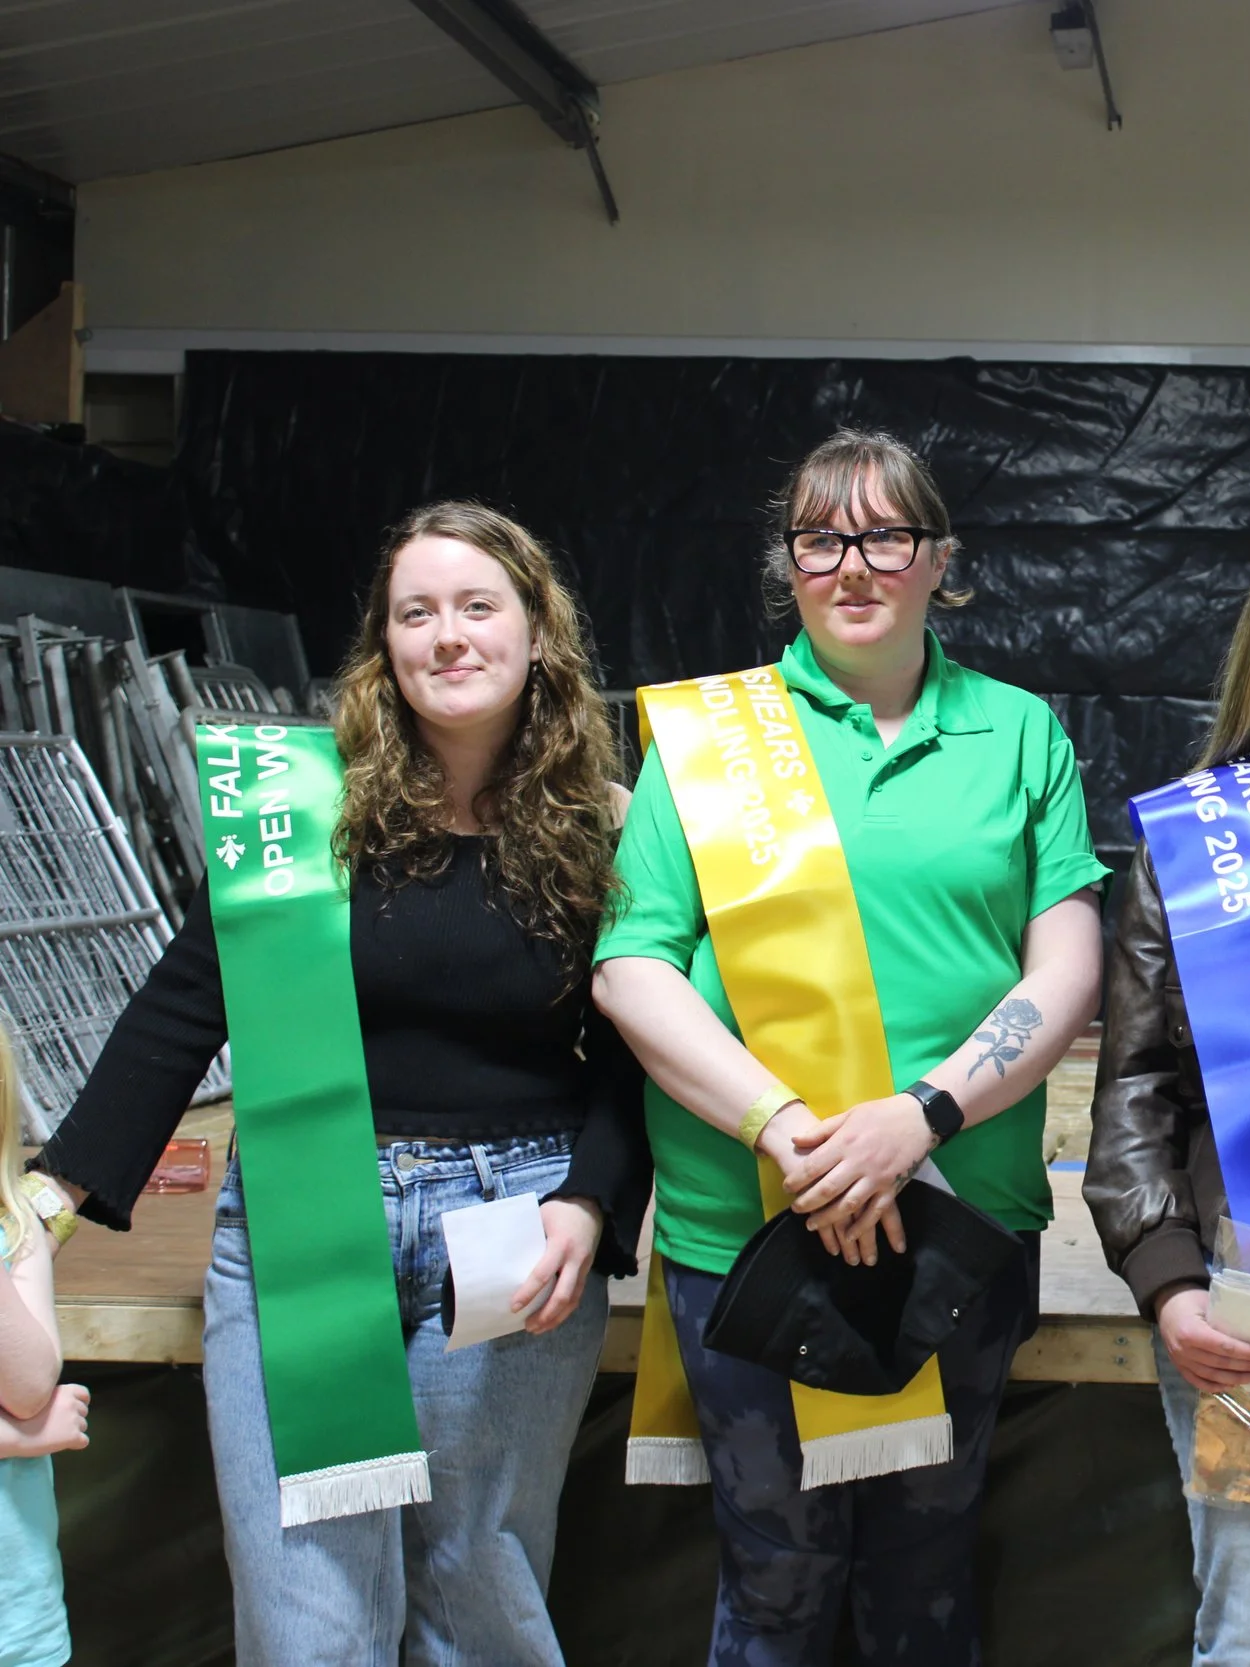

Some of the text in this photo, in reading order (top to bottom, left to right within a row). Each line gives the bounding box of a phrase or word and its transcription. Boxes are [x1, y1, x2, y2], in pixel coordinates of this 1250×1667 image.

[693, 675, 757, 785] NDLING
[739, 671, 808, 780] SHEARS
[258, 788, 295, 897] OPEN
[1181, 768, 1229, 824] ING
